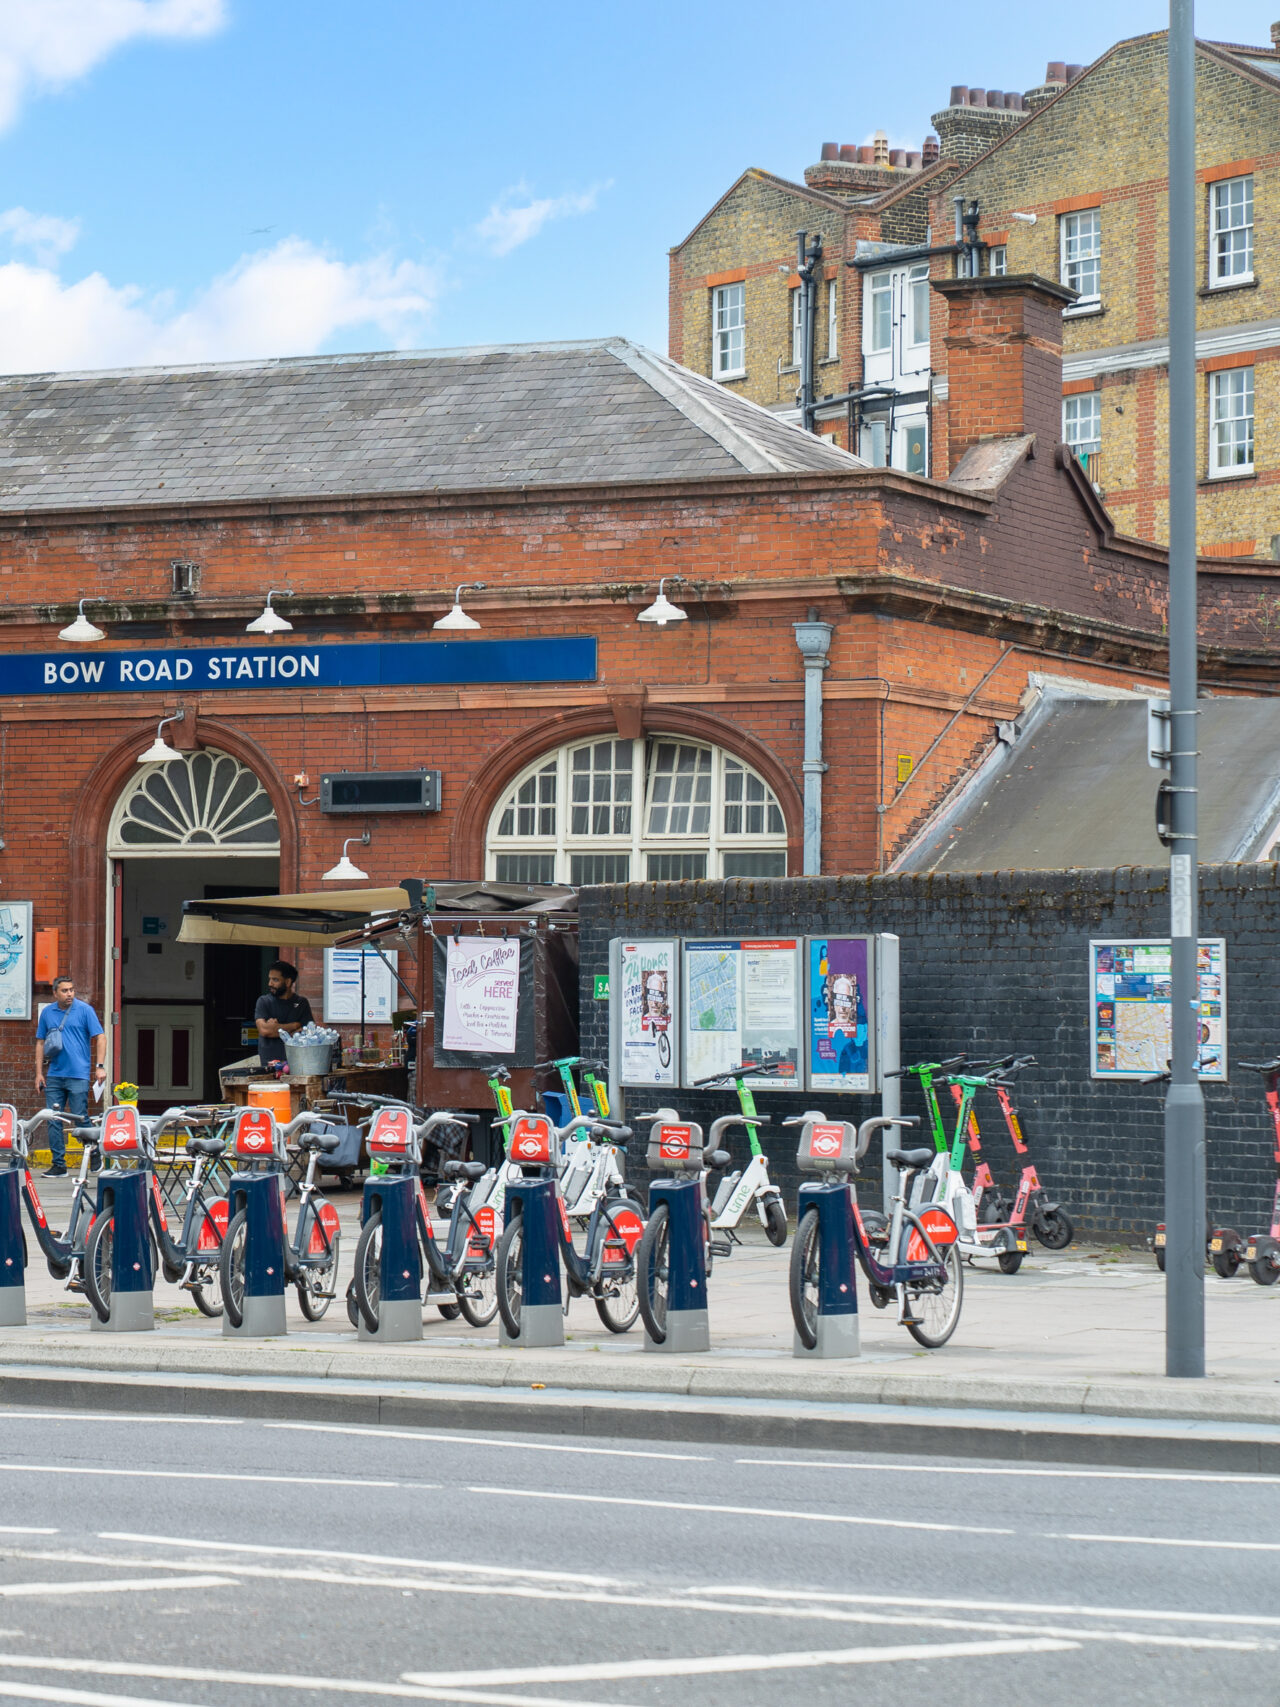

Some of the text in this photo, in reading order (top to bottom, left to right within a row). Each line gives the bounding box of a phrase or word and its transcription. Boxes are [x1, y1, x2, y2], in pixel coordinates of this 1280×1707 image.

[43, 654, 321, 685] BOW ROAD STATION
[451, 947, 516, 983] Iced Coffee
[625, 952, 669, 986] 24 HOURS
[483, 986, 513, 999] HERE
[728, 1185, 750, 1214] lime
[929, 1223, 952, 1233] Santander
